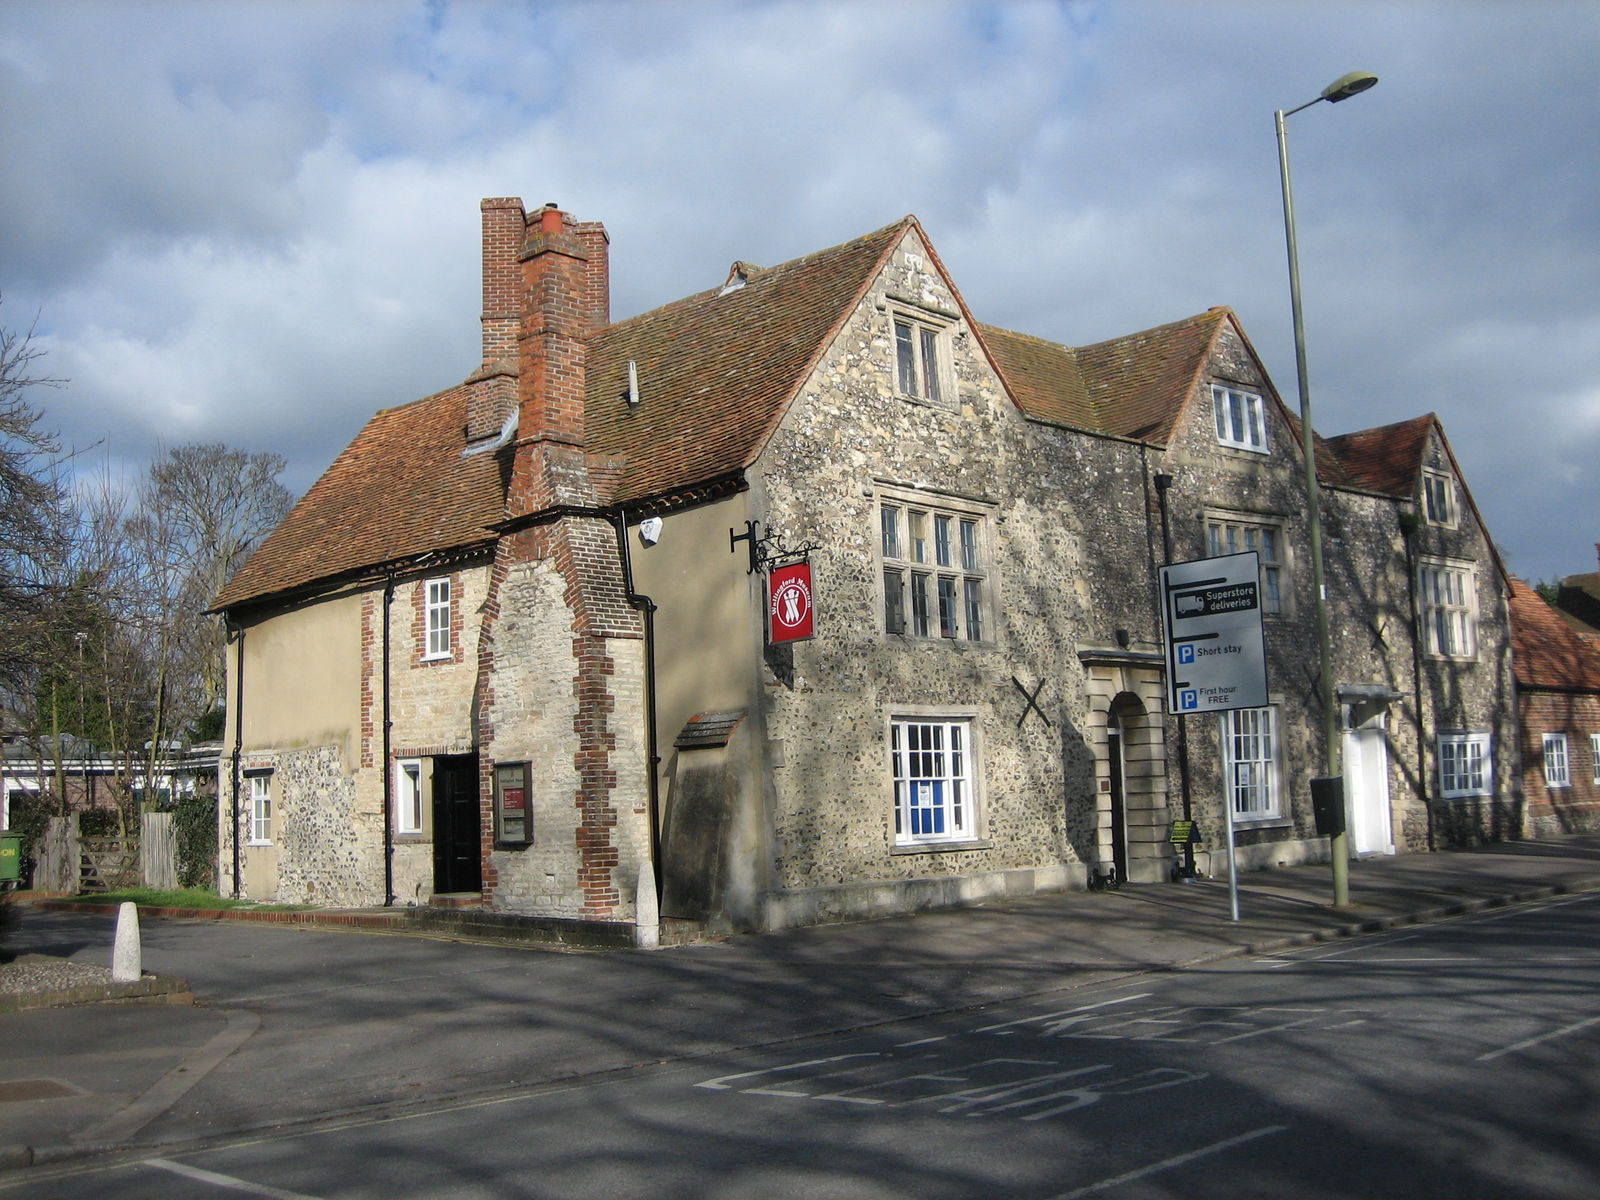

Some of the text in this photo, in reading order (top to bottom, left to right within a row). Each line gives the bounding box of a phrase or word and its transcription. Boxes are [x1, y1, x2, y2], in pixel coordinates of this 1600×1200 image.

[771, 577, 812, 615] Wallingford Museum
[1206, 587, 1254, 601] Superstore
[1210, 598, 1251, 611] deliveries
[1182, 646, 1192, 662] P
[1197, 644, 1242, 656] Short stay
[1200, 686, 1236, 695] First hour
[1184, 692, 1195, 708] P
[1208, 695, 1230, 704] FREE
[692, 1052, 1210, 1121] CLEAR
